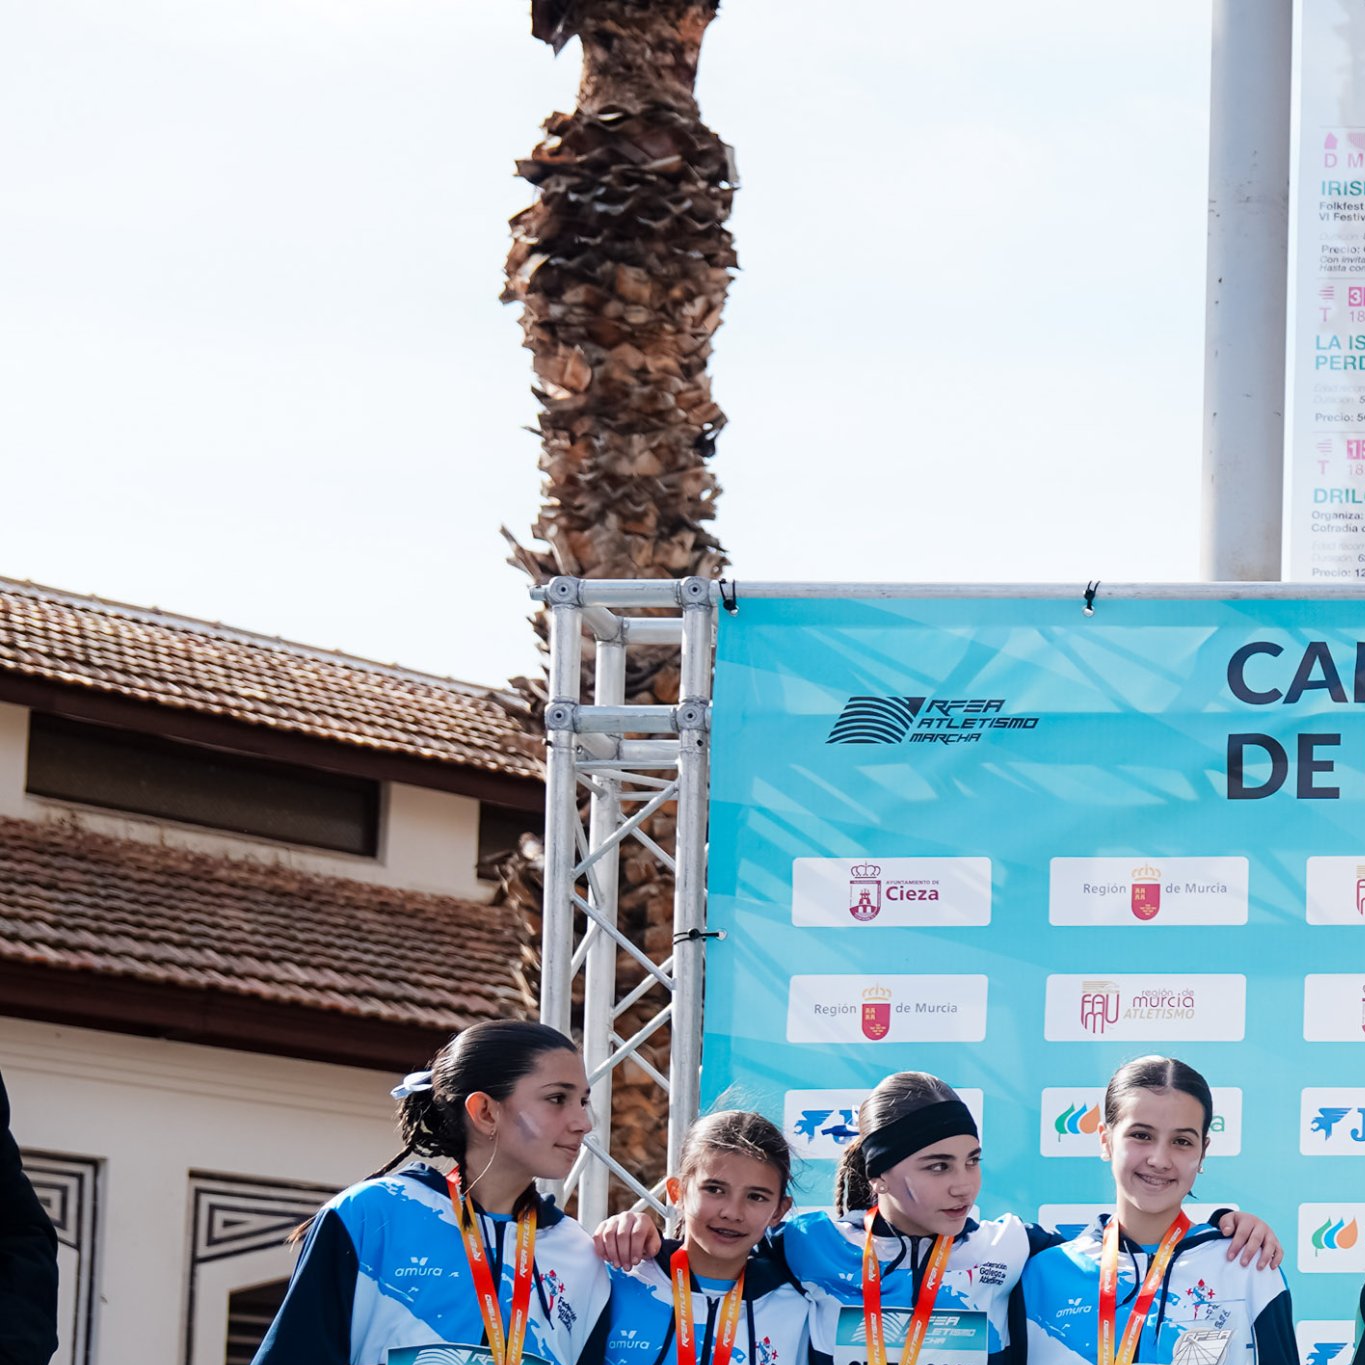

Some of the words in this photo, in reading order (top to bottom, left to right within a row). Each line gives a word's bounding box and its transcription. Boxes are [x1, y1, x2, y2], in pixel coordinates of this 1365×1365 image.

[1319, 201, 1364, 211] Folkfest
[1315, 335, 1341, 351] LA
[925, 698, 1006, 715] RFEA
[917, 717, 1040, 730] ATLETISMO
[909, 732, 983, 744] MARCHA
[1227, 731, 1341, 801] DE
[885, 885, 940, 902] Cieza
[1083, 881, 1127, 897] Región
[1165, 881, 1181, 895] de
[1185, 880, 1228, 895] Murcia
[814, 1002, 857, 1017] Región
[895, 1001, 912, 1014] de
[915, 1001, 958, 1014] Murcia
[394, 1266, 443, 1277] amura
[1056, 1304, 1092, 1318] amura
[608, 1339, 651, 1350] amura
